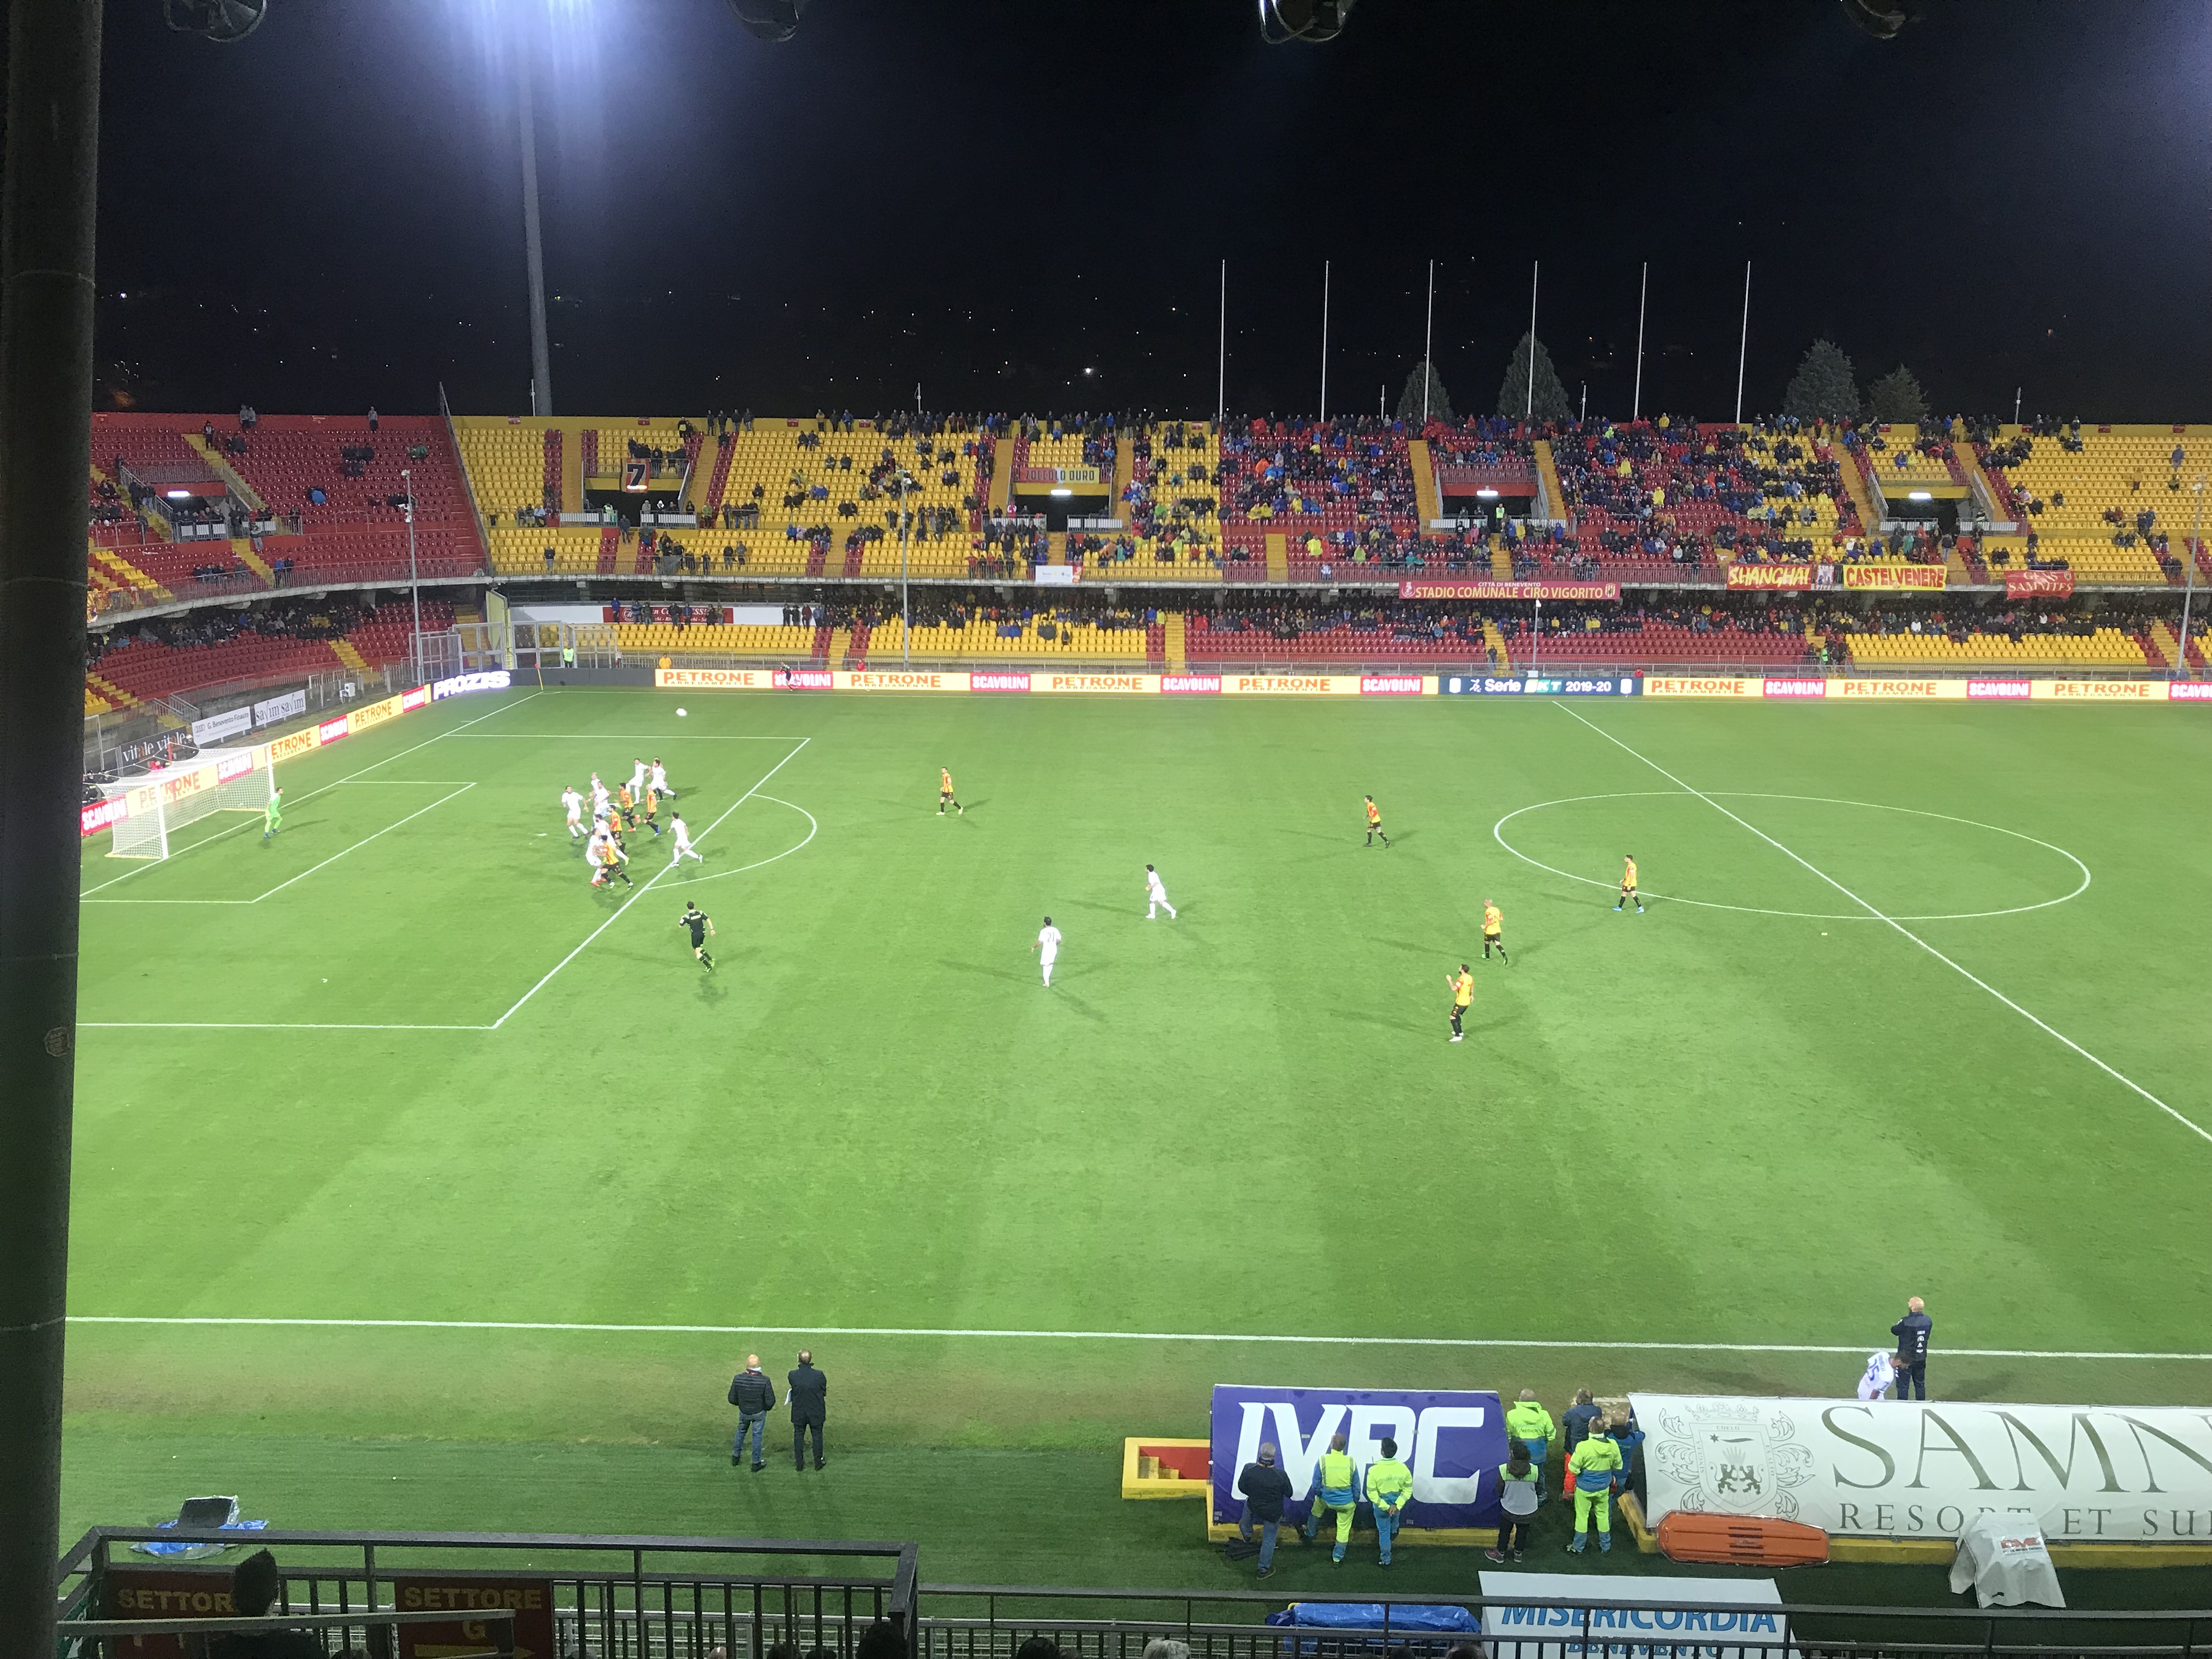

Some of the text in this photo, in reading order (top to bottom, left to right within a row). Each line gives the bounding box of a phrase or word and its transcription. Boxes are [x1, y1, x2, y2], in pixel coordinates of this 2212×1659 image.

[627, 464, 646, 486] 7
[1026, 470, 1065, 481] ZOCCOLO
[1729, 566, 1810, 587] SHANGHAI
[1415, 587, 1603, 599] STADIO COMUNALE CIRO VIGORITO
[433, 670, 511, 701] PROZIS
[664, 672, 754, 685] PETRONE
[851, 674, 941, 688] PETRONE
[972, 676, 1029, 689] SCAVOLINI
[1053, 676, 1142, 690] PETRONE
[1163, 678, 1220, 691] SCAVOLINI
[1239, 678, 1331, 691] PETRONE
[1363, 679, 1420, 692] SCAVOLINI
[1485, 679, 1521, 692] Serie
[1566, 681, 1611, 692] 2019-20
[1651, 680, 1745, 694] PETRONE
[1765, 681, 1824, 695] SCAVOLINI
[1844, 682, 1937, 696] PETRONE
[1969, 682, 2029, 696] SCAVOLINI
[2055, 684, 2150, 697] PETRONE
[355, 701, 392, 727] PETRONE
[122, 742, 154, 763] vitale
[273, 746, 307, 760] RREDAMENTI
[1047, 932, 1056, 943] 21
[1231, 1402, 1485, 1504] IVPC
[1839, 1503, 2212, 1536] RESO ET SU
[404, 1587, 541, 1609] SETTORE
[1502, 1606, 1777, 1633] MISERICORDIA
[464, 1620, 486, 1639] G
